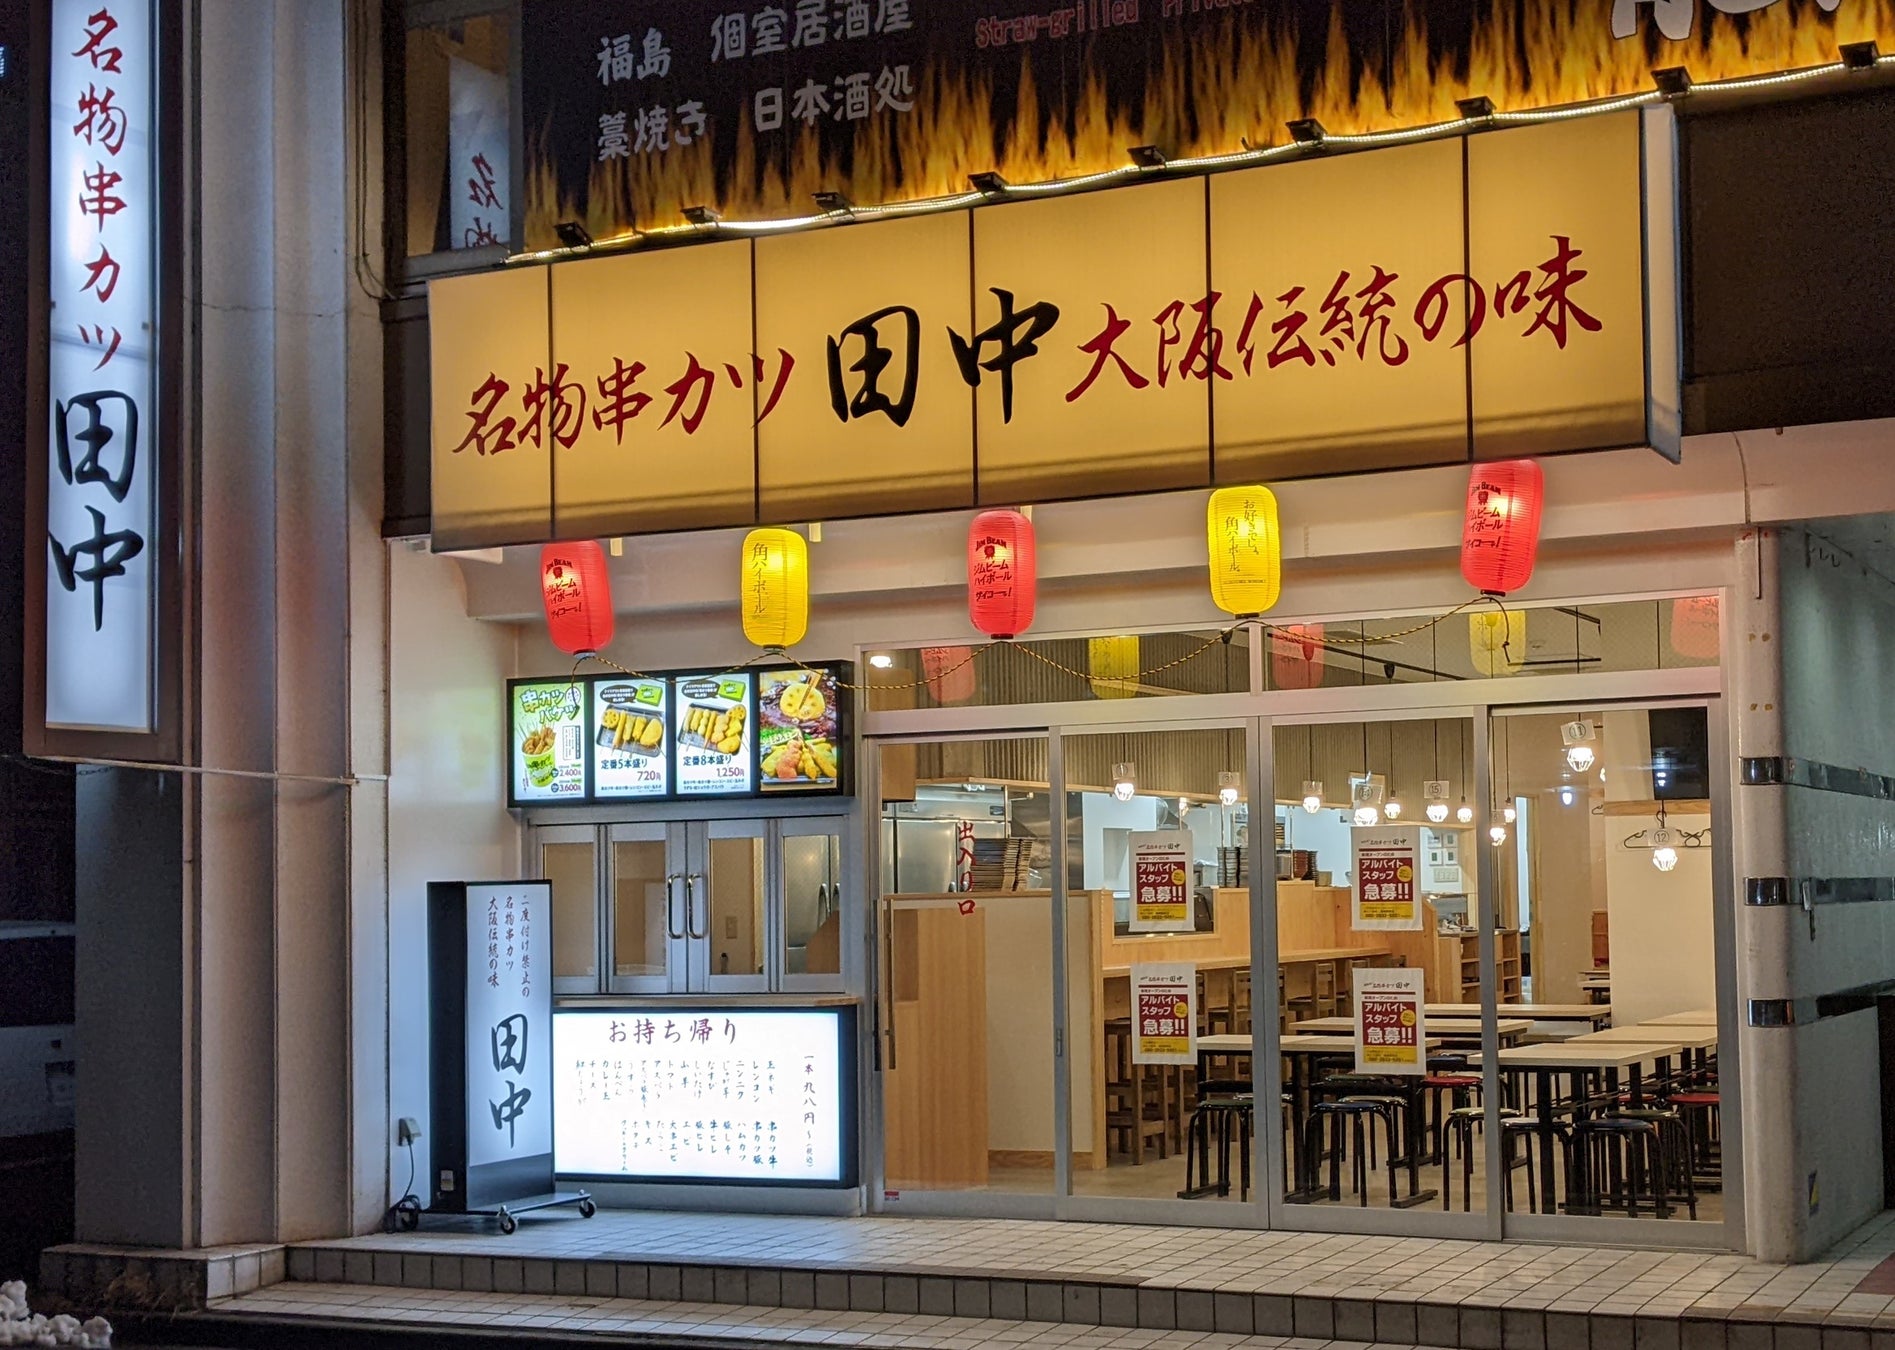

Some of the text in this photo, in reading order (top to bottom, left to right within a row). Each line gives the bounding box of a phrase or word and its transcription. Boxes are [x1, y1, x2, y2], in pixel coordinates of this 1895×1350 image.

[597, 0, 914, 86] 福島 個室居酒屋
[597, 64, 914, 161] 藁焼き 日本酒処
[48, 8, 144, 633] 名物串カツ 田中
[453, 234, 1604, 456] 名物串カツ 田中 大阪伝統の味
[974, 559, 1009, 574] ジムビーム
[974, 571, 1012, 586] ハイボール
[521, 688, 565, 713] 串カツ
[539, 705, 580, 725] バケツ
[601, 758, 648, 769] 定番5本盛り
[683, 755, 732, 766] 定番8本盛り
[1138, 863, 1178, 872] アルバイト
[1361, 859, 1404, 869] アルバイト
[1139, 874, 1169, 883] スタッフ
[1362, 871, 1395, 880] スタッフ
[1140, 886, 1183, 903] 急募!!
[1364, 883, 1409, 900] 急募!!
[504, 895, 515, 971] 名物串カツ
[487, 895, 500, 989] 大阪伝統の味
[520, 894, 531, 998] 二度付け禁止の
[1140, 995, 1180, 1005] アルバイト
[1364, 1002, 1407, 1012] アルバイト
[1141, 1006, 1171, 1016] スタッフ
[1365, 1014, 1398, 1024] スタッフ
[608, 1018, 737, 1046] お持ち帰り
[1143, 1018, 1185, 1035] 急募!!
[1367, 1026, 1412, 1044] 急募!!
[489, 1013, 532, 1149] 田中
[736, 1060, 745, 1100] ニンニク
[752, 1060, 760, 1103] レンコン
[737, 1122, 746, 1161] ハムカツ
